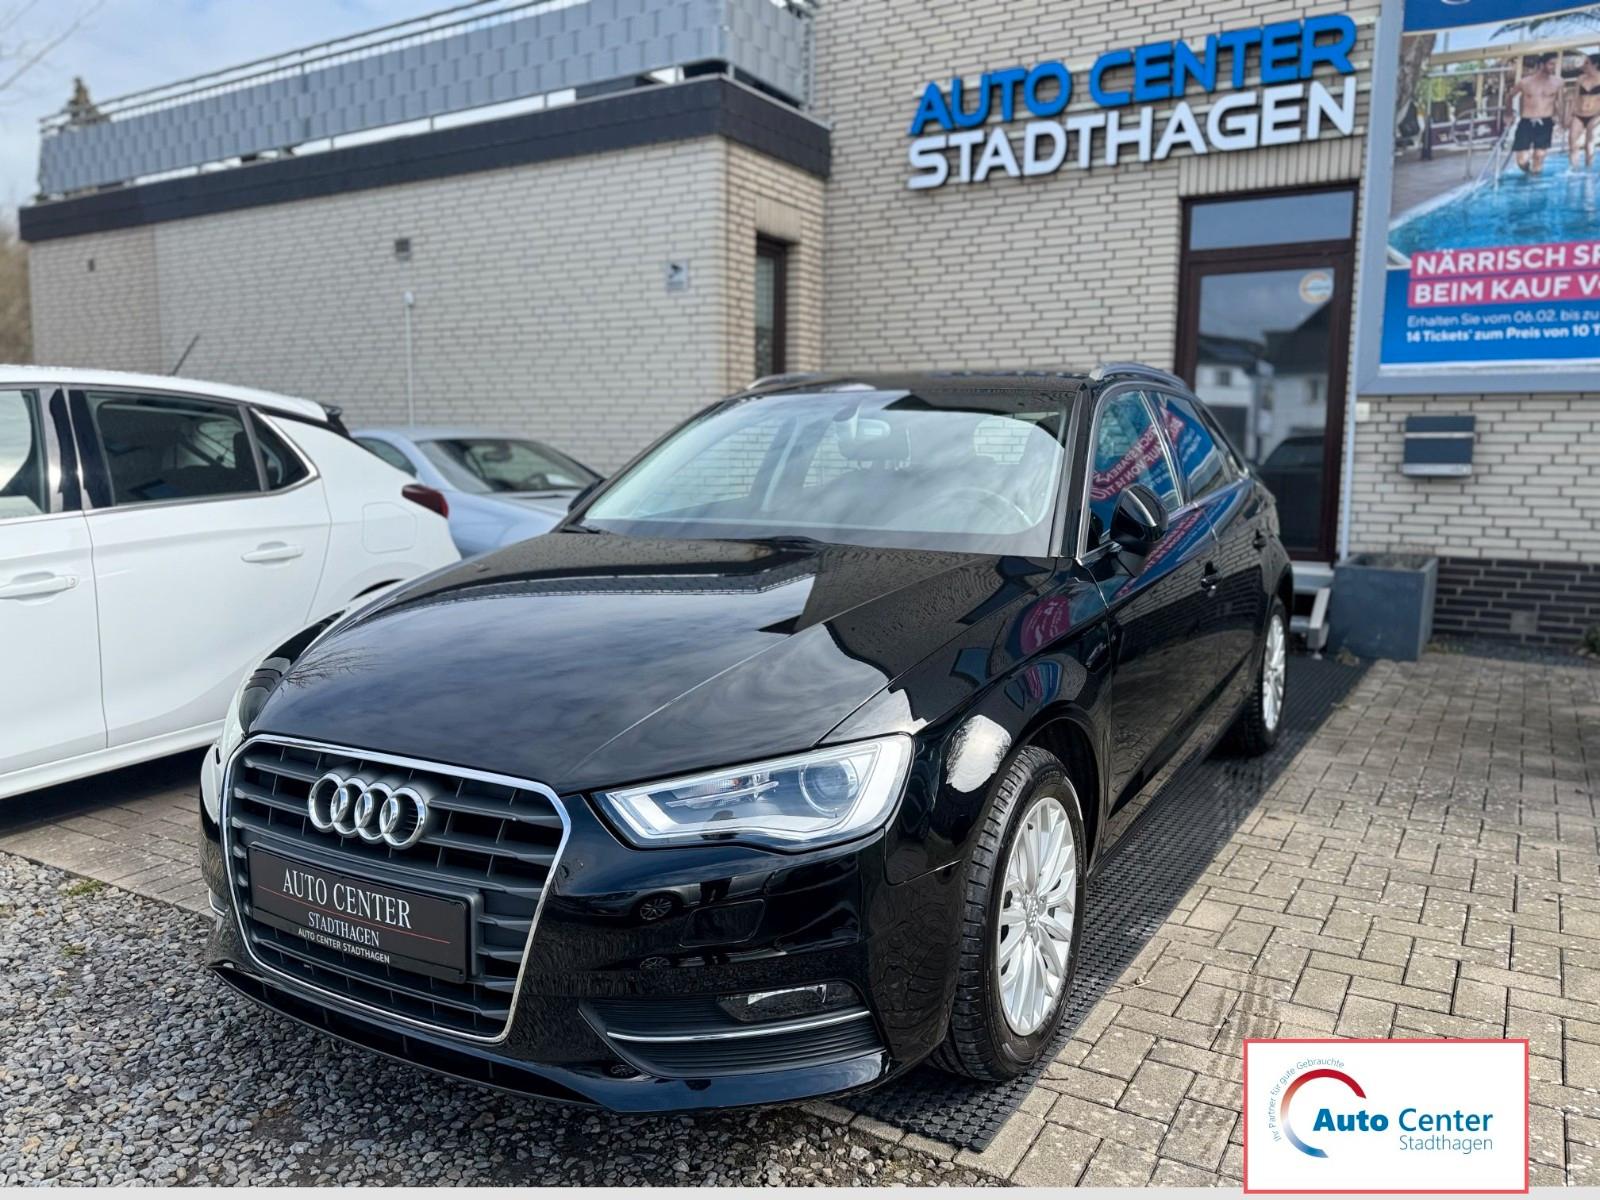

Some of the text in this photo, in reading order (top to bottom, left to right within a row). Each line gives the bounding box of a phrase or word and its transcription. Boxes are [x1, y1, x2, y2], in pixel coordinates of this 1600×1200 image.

[910, 13, 1357, 135] AUTO CENTER
[907, 76, 1356, 190] STADTHAGEN
[1416, 246, 1566, 276] NÄRRISCH
[1414, 274, 1600, 304] BEIM KAUF V
[1406, 330, 1421, 343] 14
[1474, 330, 1504, 341] zum
[1506, 326, 1541, 339] Preis
[1542, 327, 1570, 338] von
[1572, 323, 1590, 337] 10
[1407, 314, 1459, 328] Erhalten
[1461, 312, 1481, 326] Sie
[1482, 314, 1512, 324] vom
[1560, 309, 1580, 321] bis
[282, 868, 412, 929] AUTO CENTER
[298, 928, 390, 964] AUTO CENTER STADTHAGEN
[308, 911, 380, 947] STADTHAGEN
